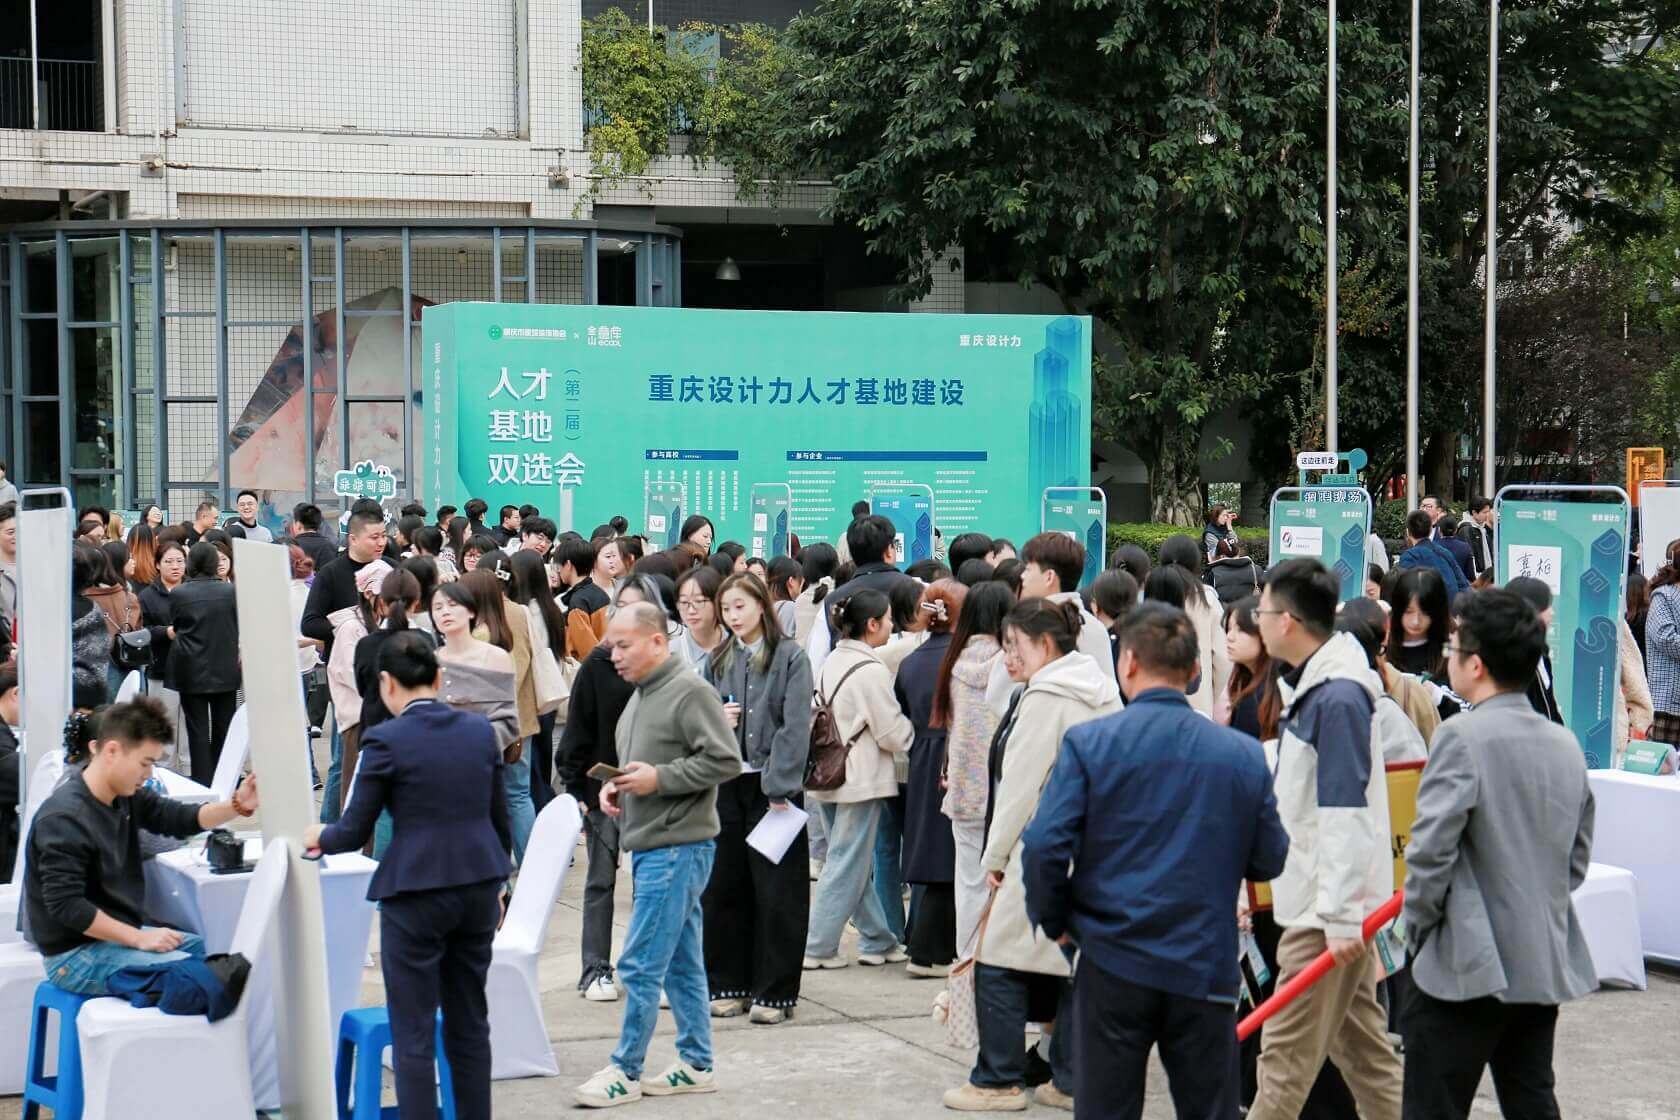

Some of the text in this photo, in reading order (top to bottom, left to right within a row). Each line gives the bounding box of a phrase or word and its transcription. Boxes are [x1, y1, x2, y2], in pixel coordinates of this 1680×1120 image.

[959, 334, 1022, 347] 重庆设计力
[488, 366, 553, 401] 人才
[648, 374, 965, 405] 重庆设计力人才基地建设
[488, 409, 553, 443] 基地
[488, 452, 586, 486] 双选会
